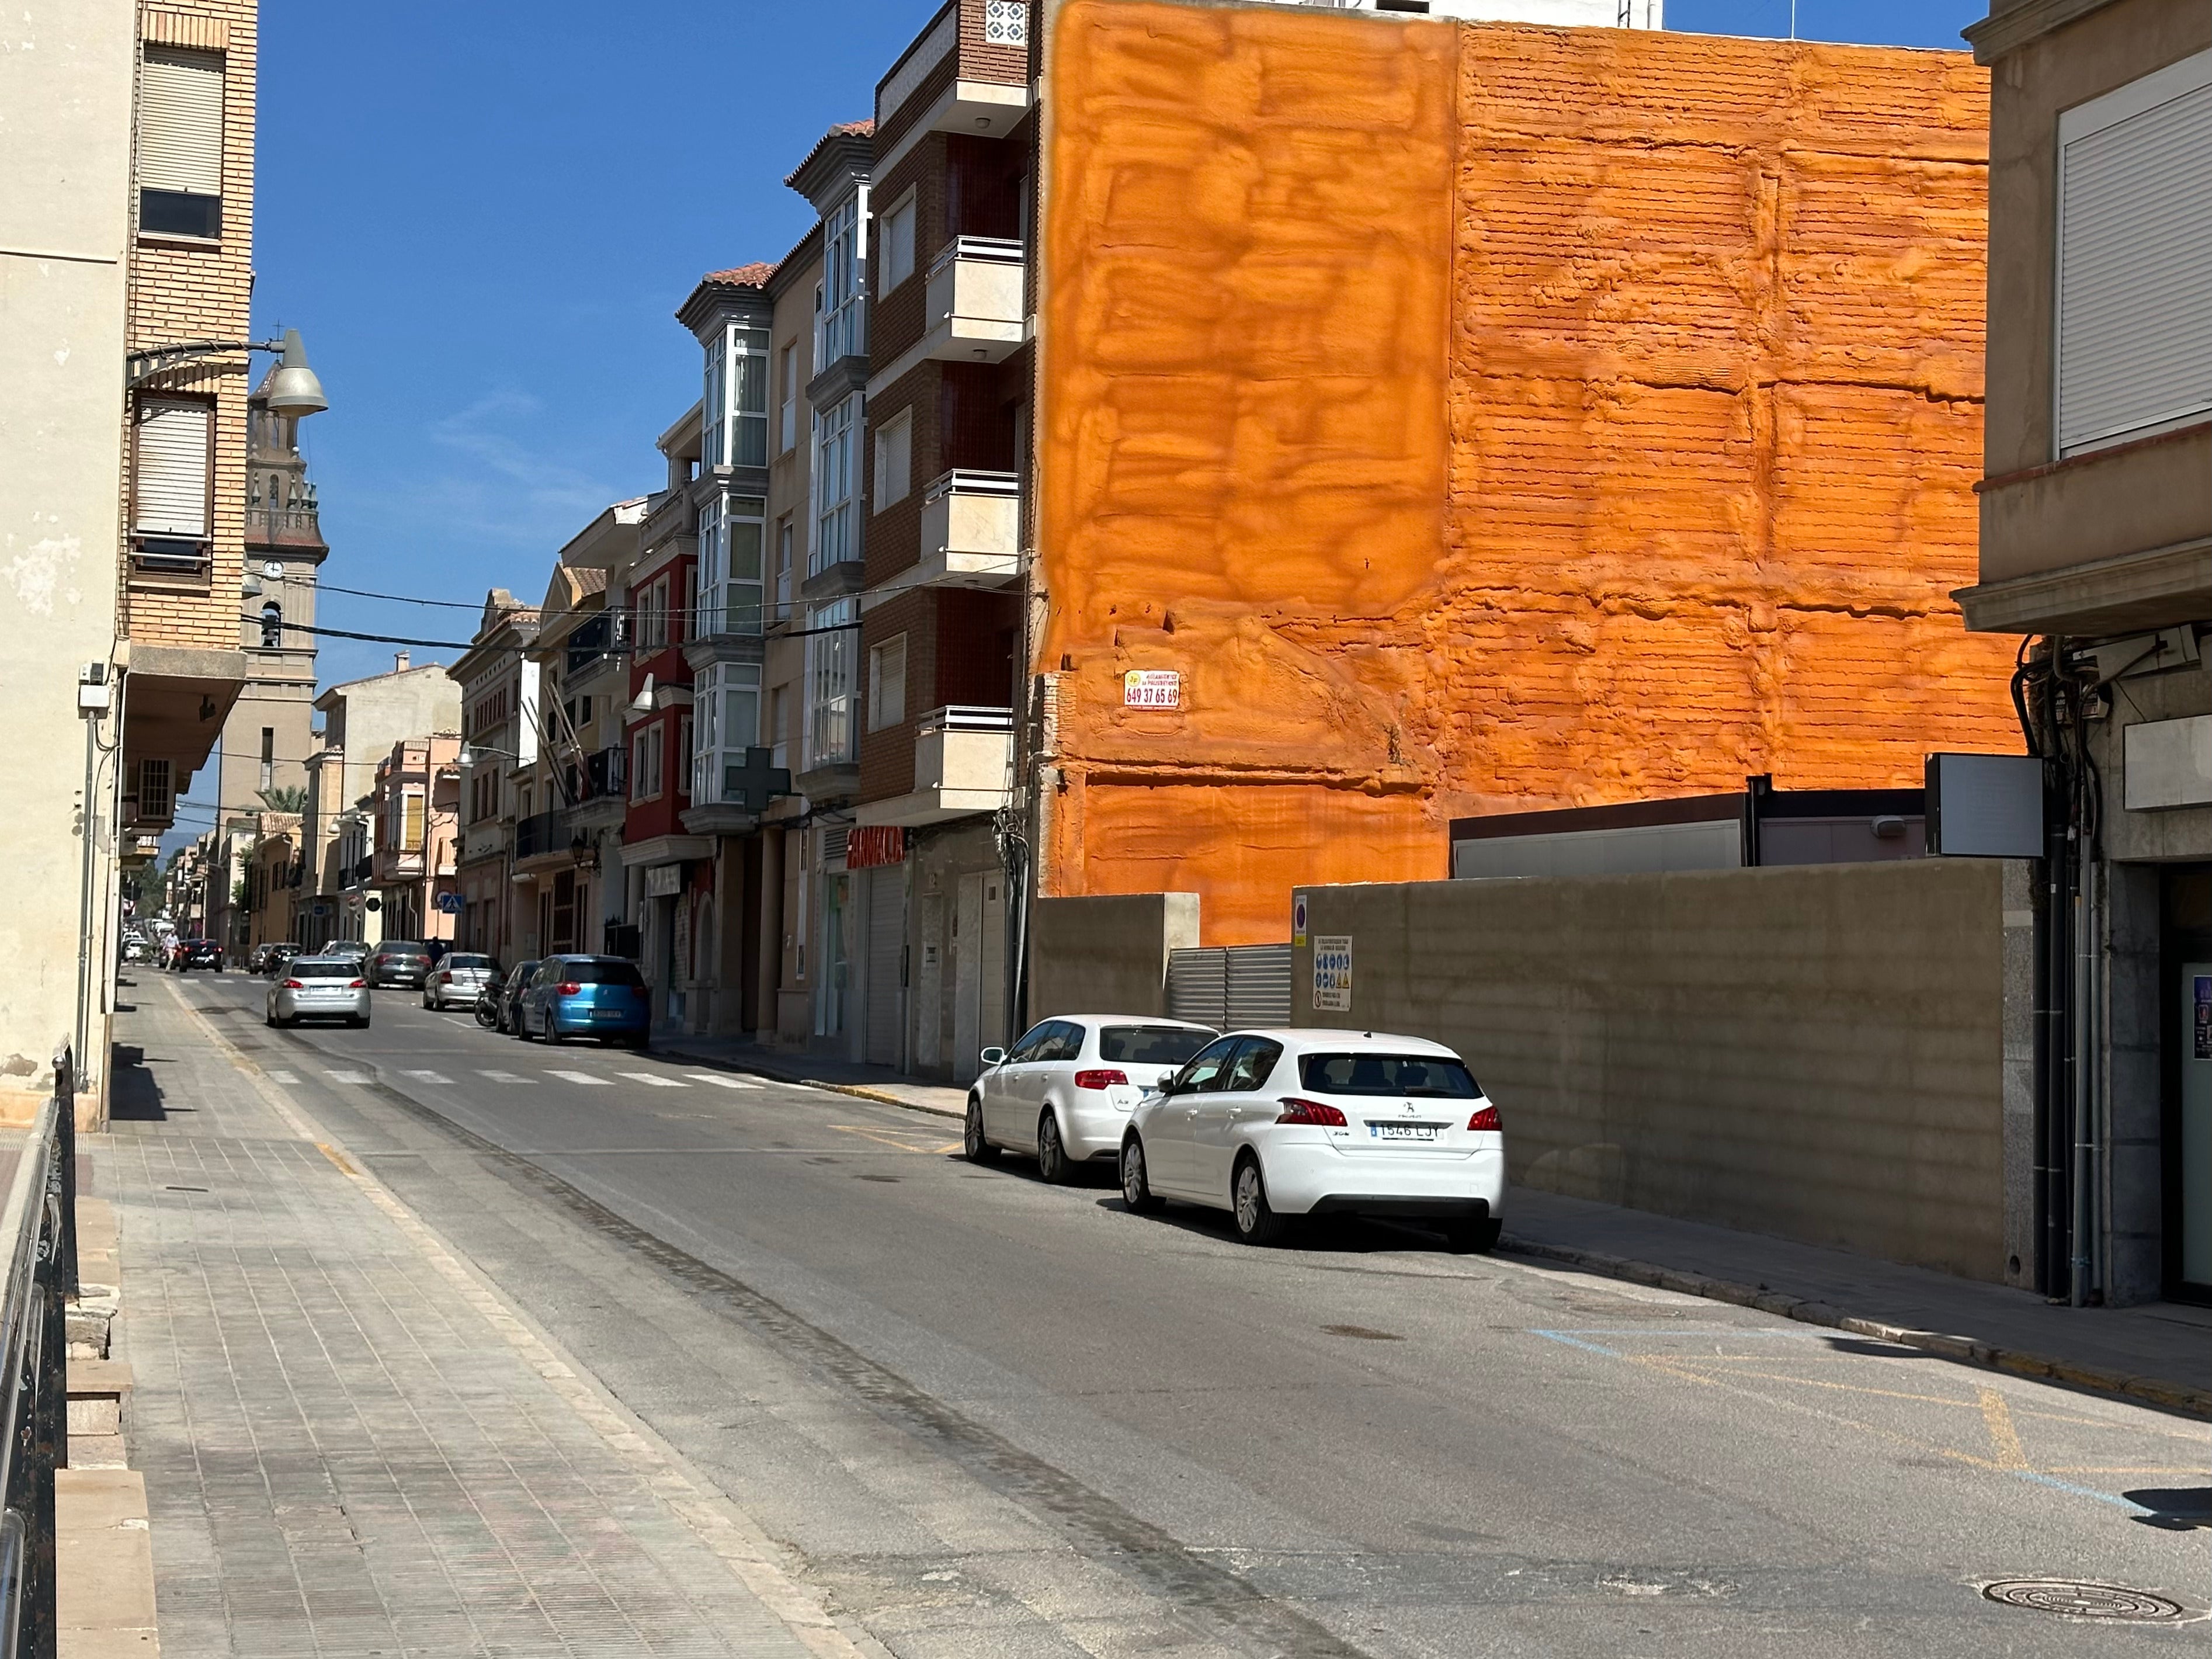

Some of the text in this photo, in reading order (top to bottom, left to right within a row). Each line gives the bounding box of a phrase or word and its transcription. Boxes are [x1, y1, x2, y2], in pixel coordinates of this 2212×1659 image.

[1127, 688, 1178, 704] 649 37 65 69
[1380, 1123, 1439, 1137] 1546 LJY
